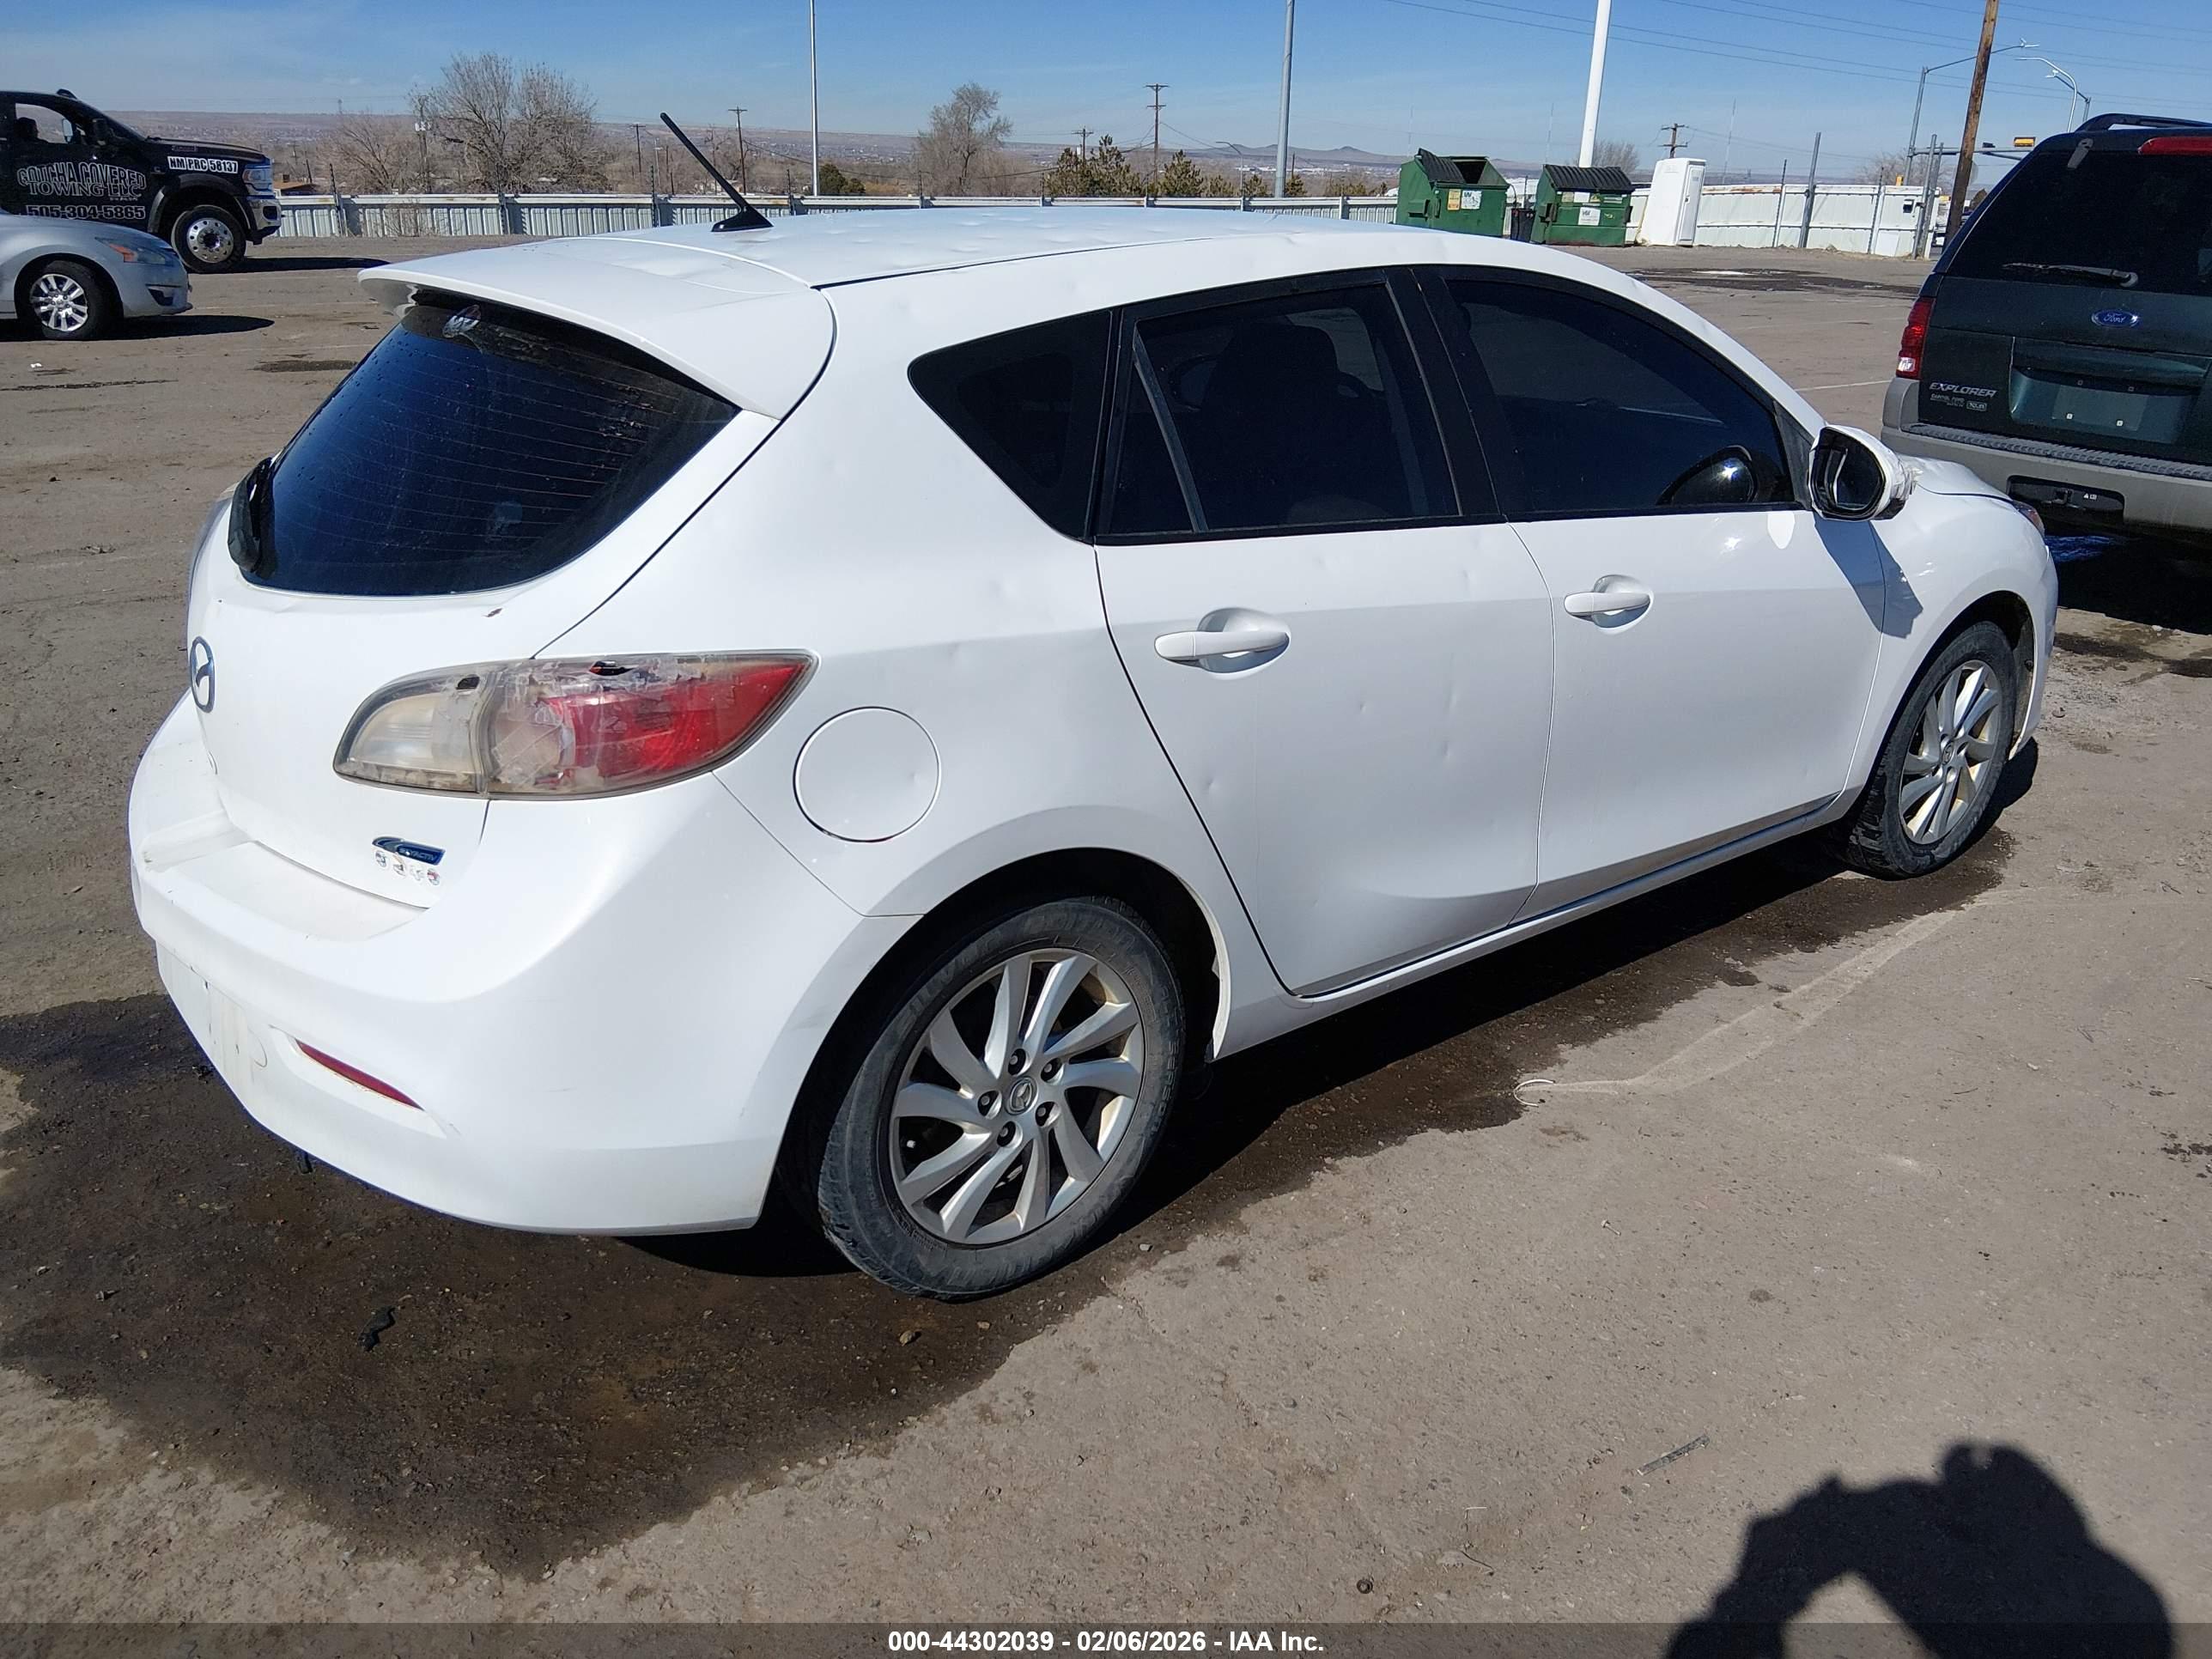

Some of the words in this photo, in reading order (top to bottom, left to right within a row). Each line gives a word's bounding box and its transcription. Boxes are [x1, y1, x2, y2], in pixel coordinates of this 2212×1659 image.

[167, 157, 186, 169] NM
[187, 158, 208, 171] PRC
[209, 159, 238, 173] 58137
[78, 162, 147, 190] COVERED
[26, 181, 105, 197] TOWING
[108, 184, 142, 198] LLC
[27, 205, 146, 220] 505-304-5865
[1929, 382, 1998, 397] EXPLORER
